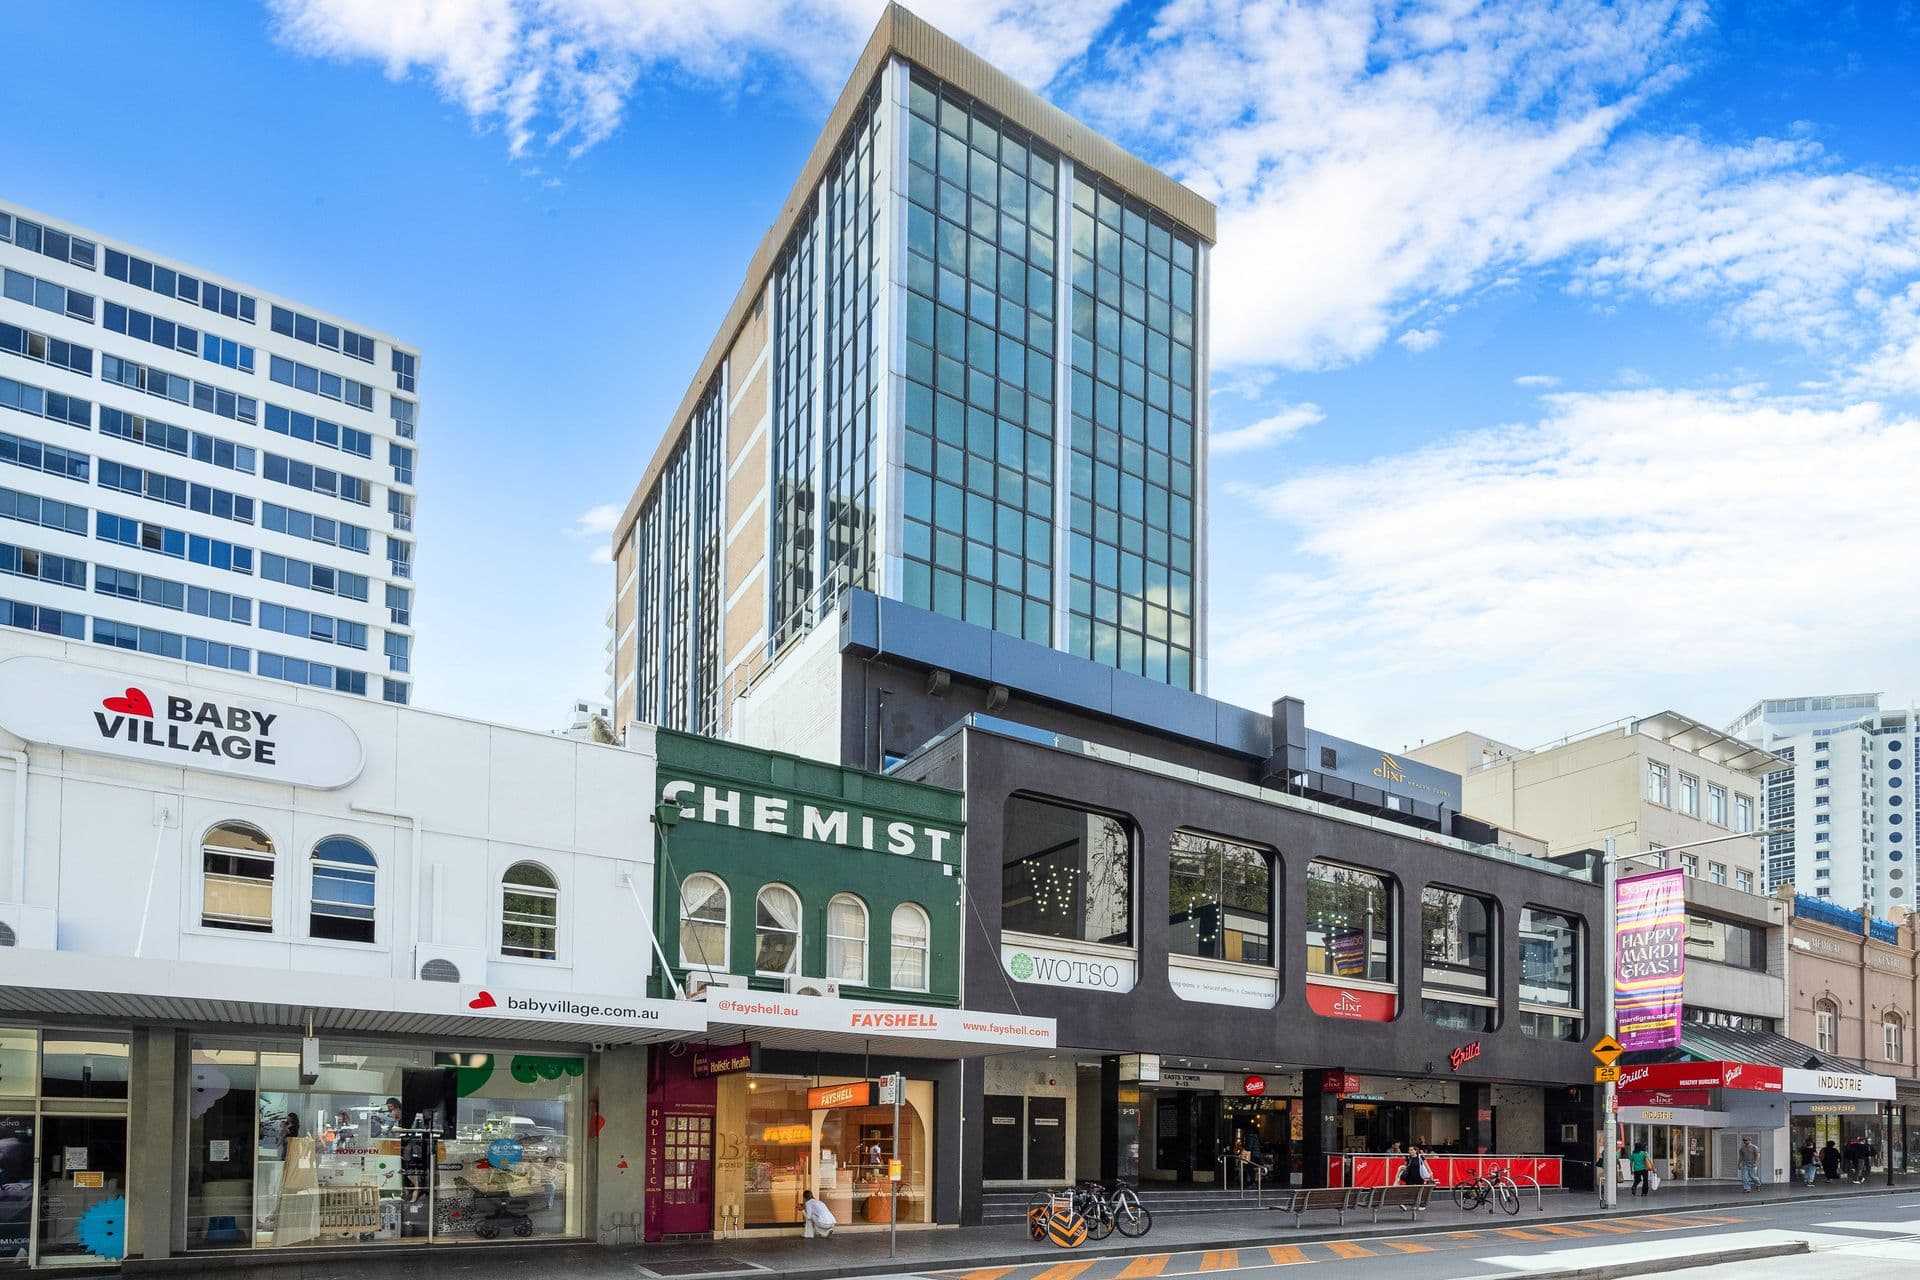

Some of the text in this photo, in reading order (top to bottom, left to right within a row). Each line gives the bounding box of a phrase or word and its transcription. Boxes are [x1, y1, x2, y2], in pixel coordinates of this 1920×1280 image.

[168, 695, 277, 736] BABY
[94, 711, 276, 765] VILLAGE
[1373, 761, 1406, 783] elixr
[1622, 927, 1678, 948] HAPPY
[1622, 942, 1678, 963] MARDI
[1033, 956, 1119, 987] WOTSO
[507, 996, 659, 1020] babyvillage.com.au
[718, 999, 799, 1017] @fayshell.au
[1334, 996, 1362, 1012] elixr
[851, 1013, 937, 1027] FAYSHELL
[962, 1021, 1050, 1038] www.fayshell.com
[1449, 1040, 1481, 1071] Grill'd
[1617, 1066, 1649, 1088] Grill'd
[1818, 1076, 1862, 1091] INDUSTRIE
[821, 1088, 853, 1106] FAYSHELL
[650, 1109, 659, 1184] HOLISTIC
